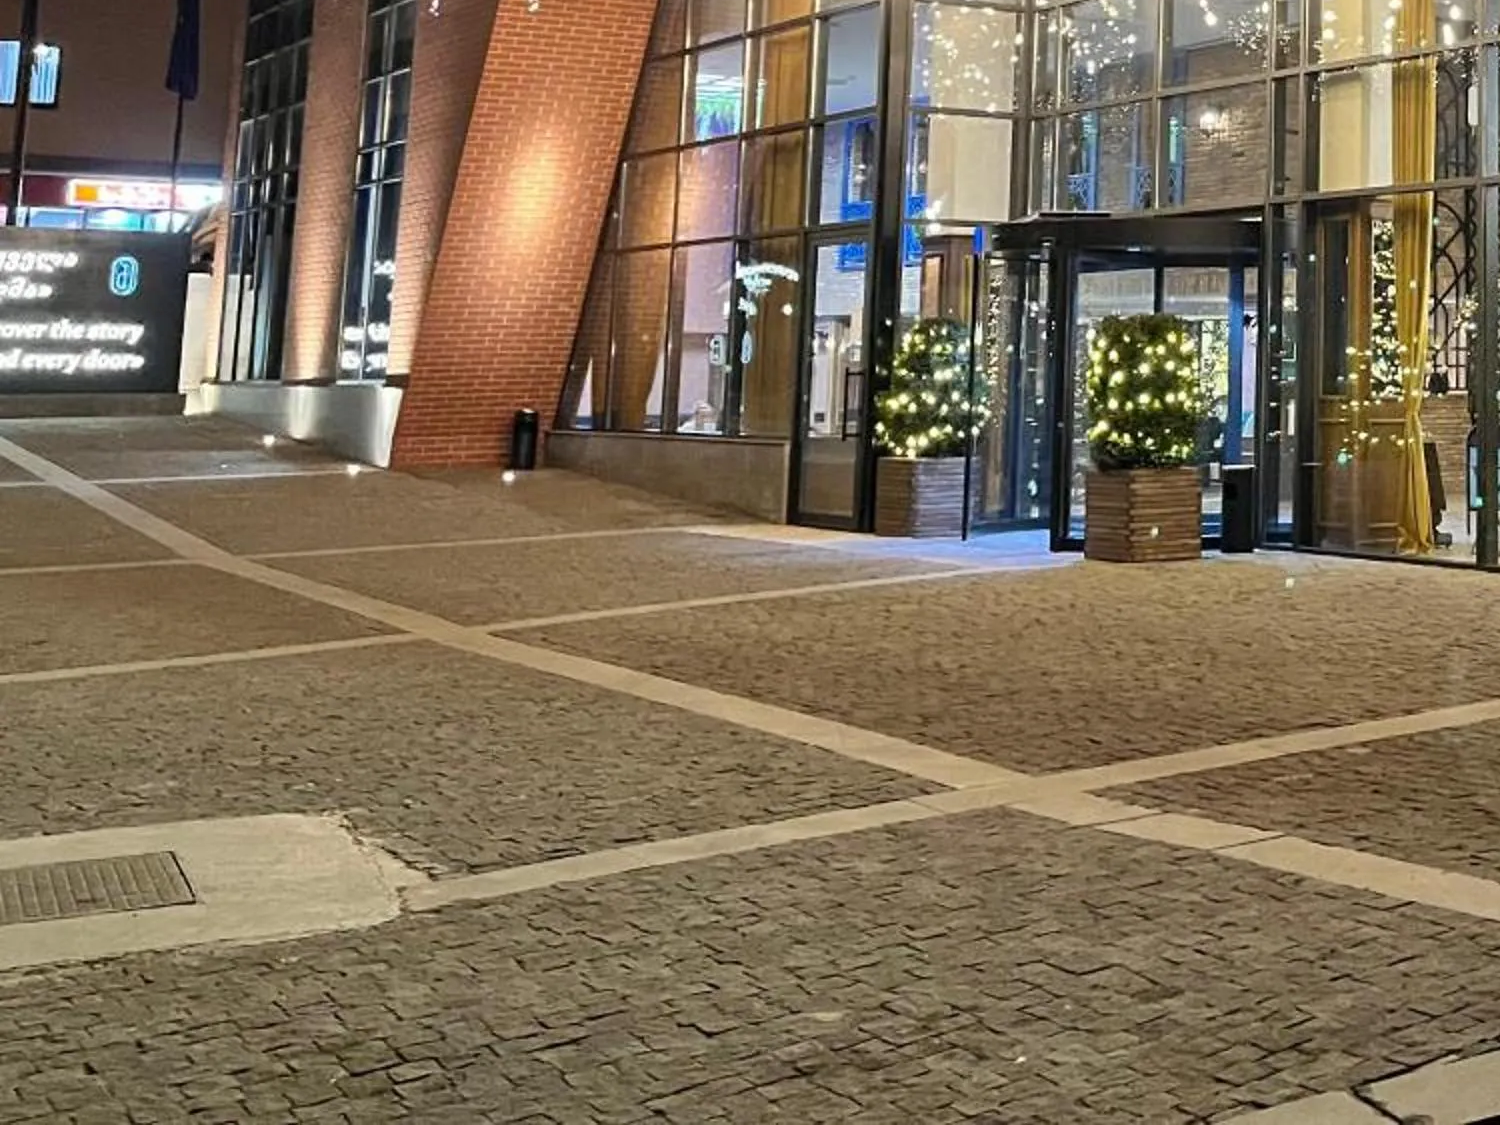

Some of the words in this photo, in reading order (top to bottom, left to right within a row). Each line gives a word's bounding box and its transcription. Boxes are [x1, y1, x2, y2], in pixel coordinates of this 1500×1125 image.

[49, 317, 85, 339] the
[86, 323, 145, 345] story
[22, 353, 82, 374] every
